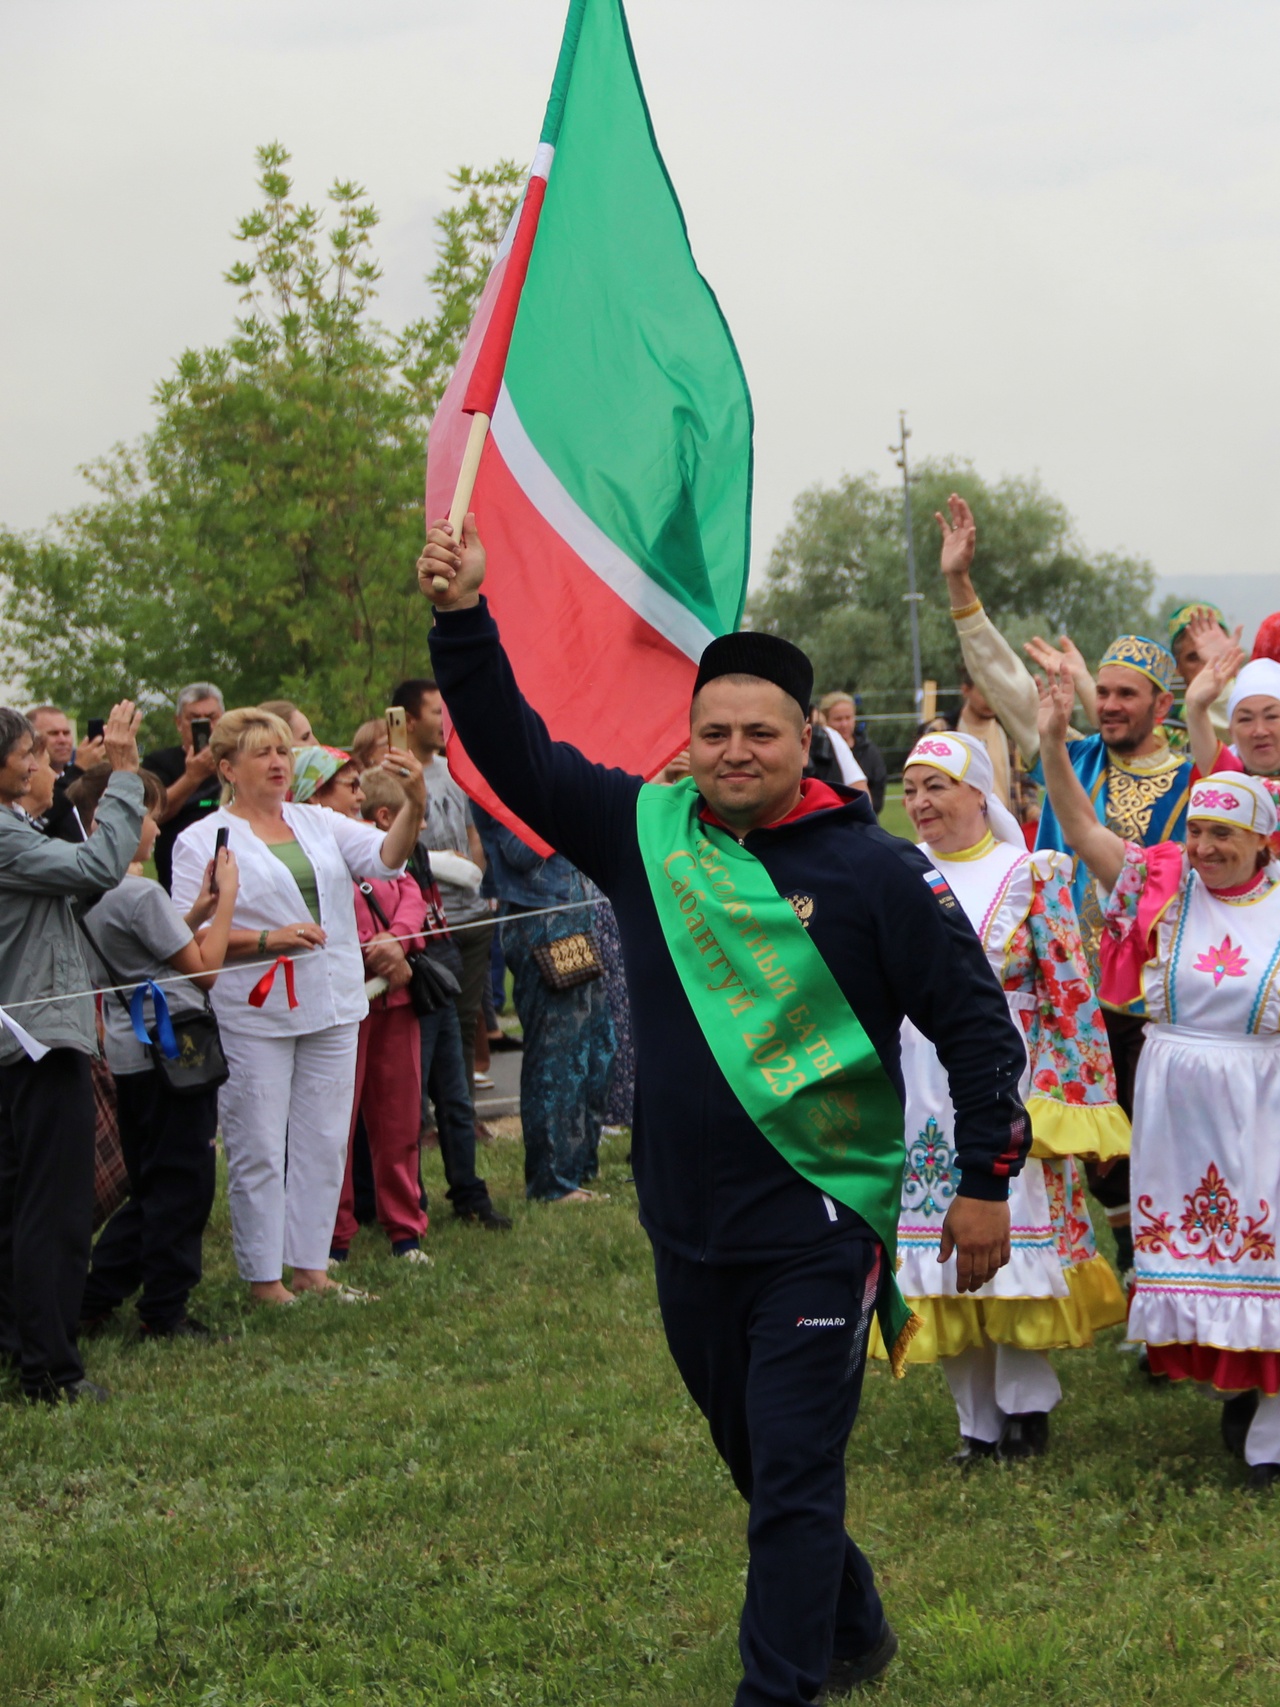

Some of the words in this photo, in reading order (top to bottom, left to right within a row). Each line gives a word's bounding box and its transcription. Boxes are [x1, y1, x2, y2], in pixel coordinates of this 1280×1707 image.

[663, 849, 760, 1018] Сабантуй
[742, 1020, 807, 1097] 2023
[796, 1316, 846, 1327] FORWARD
